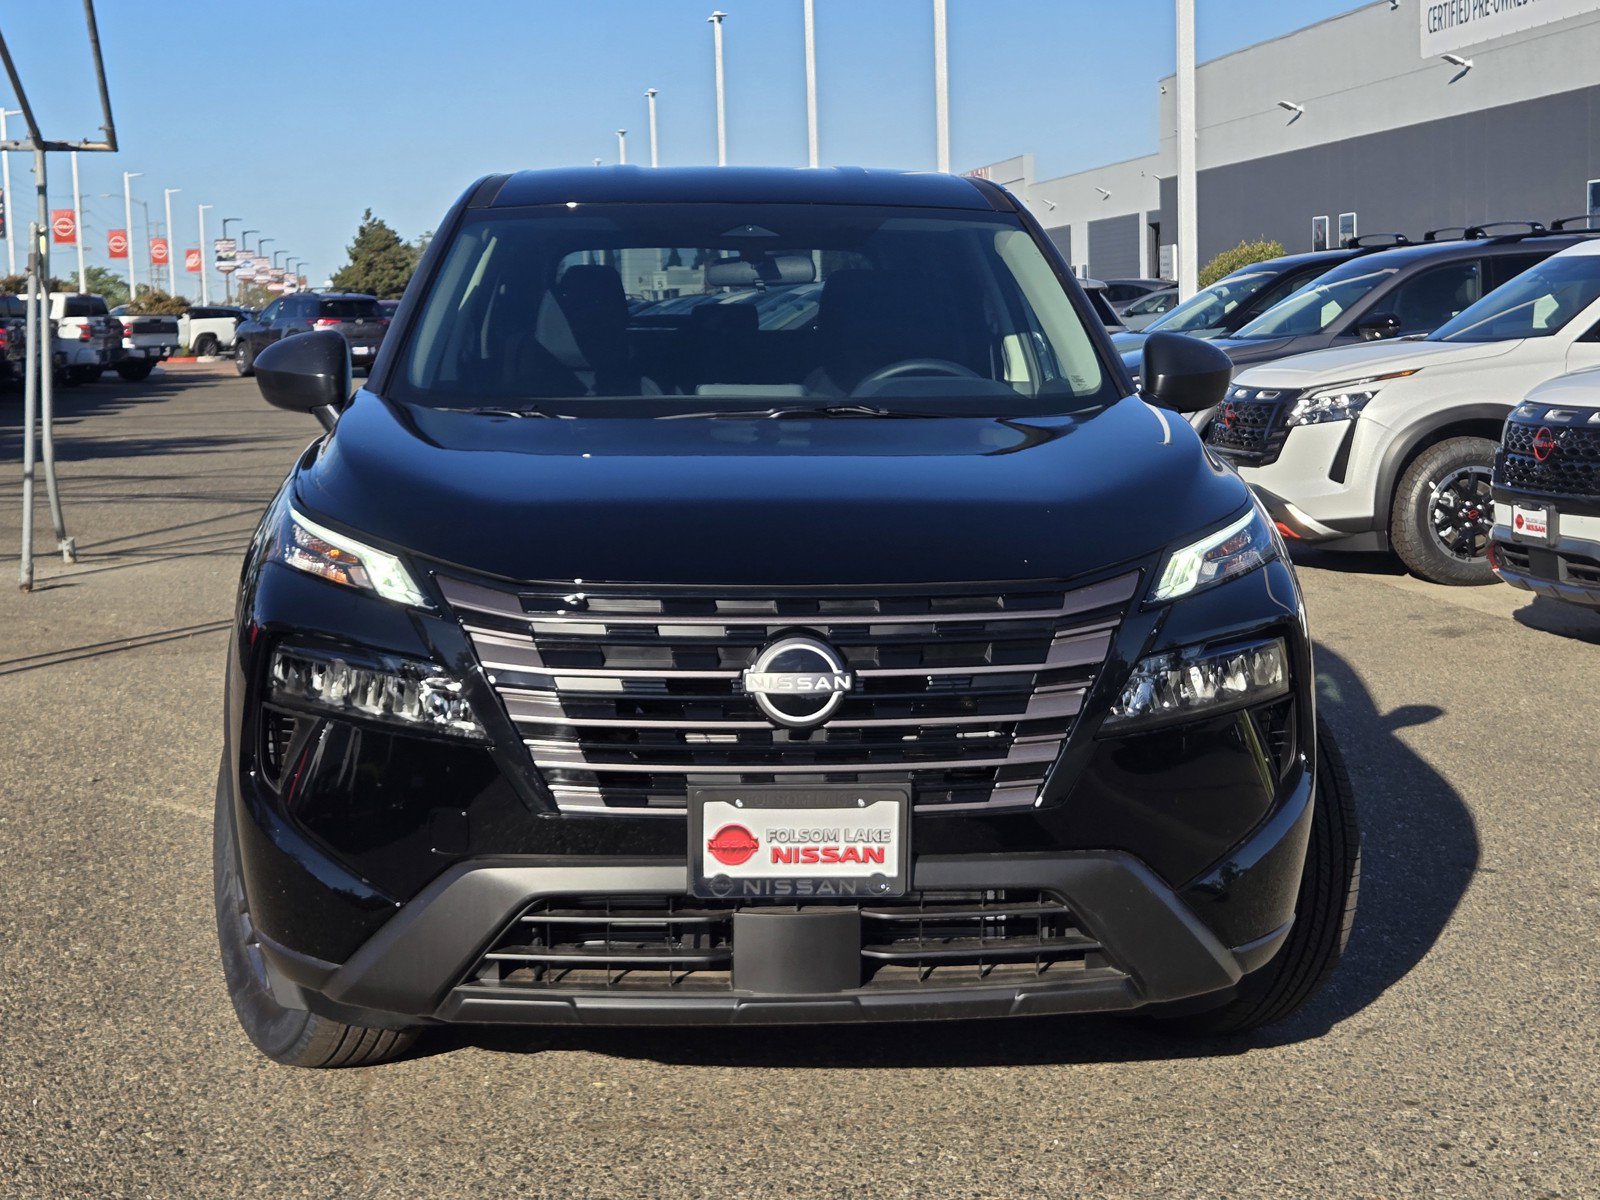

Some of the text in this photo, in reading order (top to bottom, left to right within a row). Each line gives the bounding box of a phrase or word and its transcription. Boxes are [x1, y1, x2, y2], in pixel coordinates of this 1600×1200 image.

[1428, 0, 1527, 33] CERTIFIED PRE-O
[749, 675, 850, 690] NISSAN
[766, 828, 891, 843] FOLSOM LAKE
[708, 840, 758, 849] NISSAN
[771, 846, 885, 863] NISSAN
[743, 879, 857, 895] NISSAN
